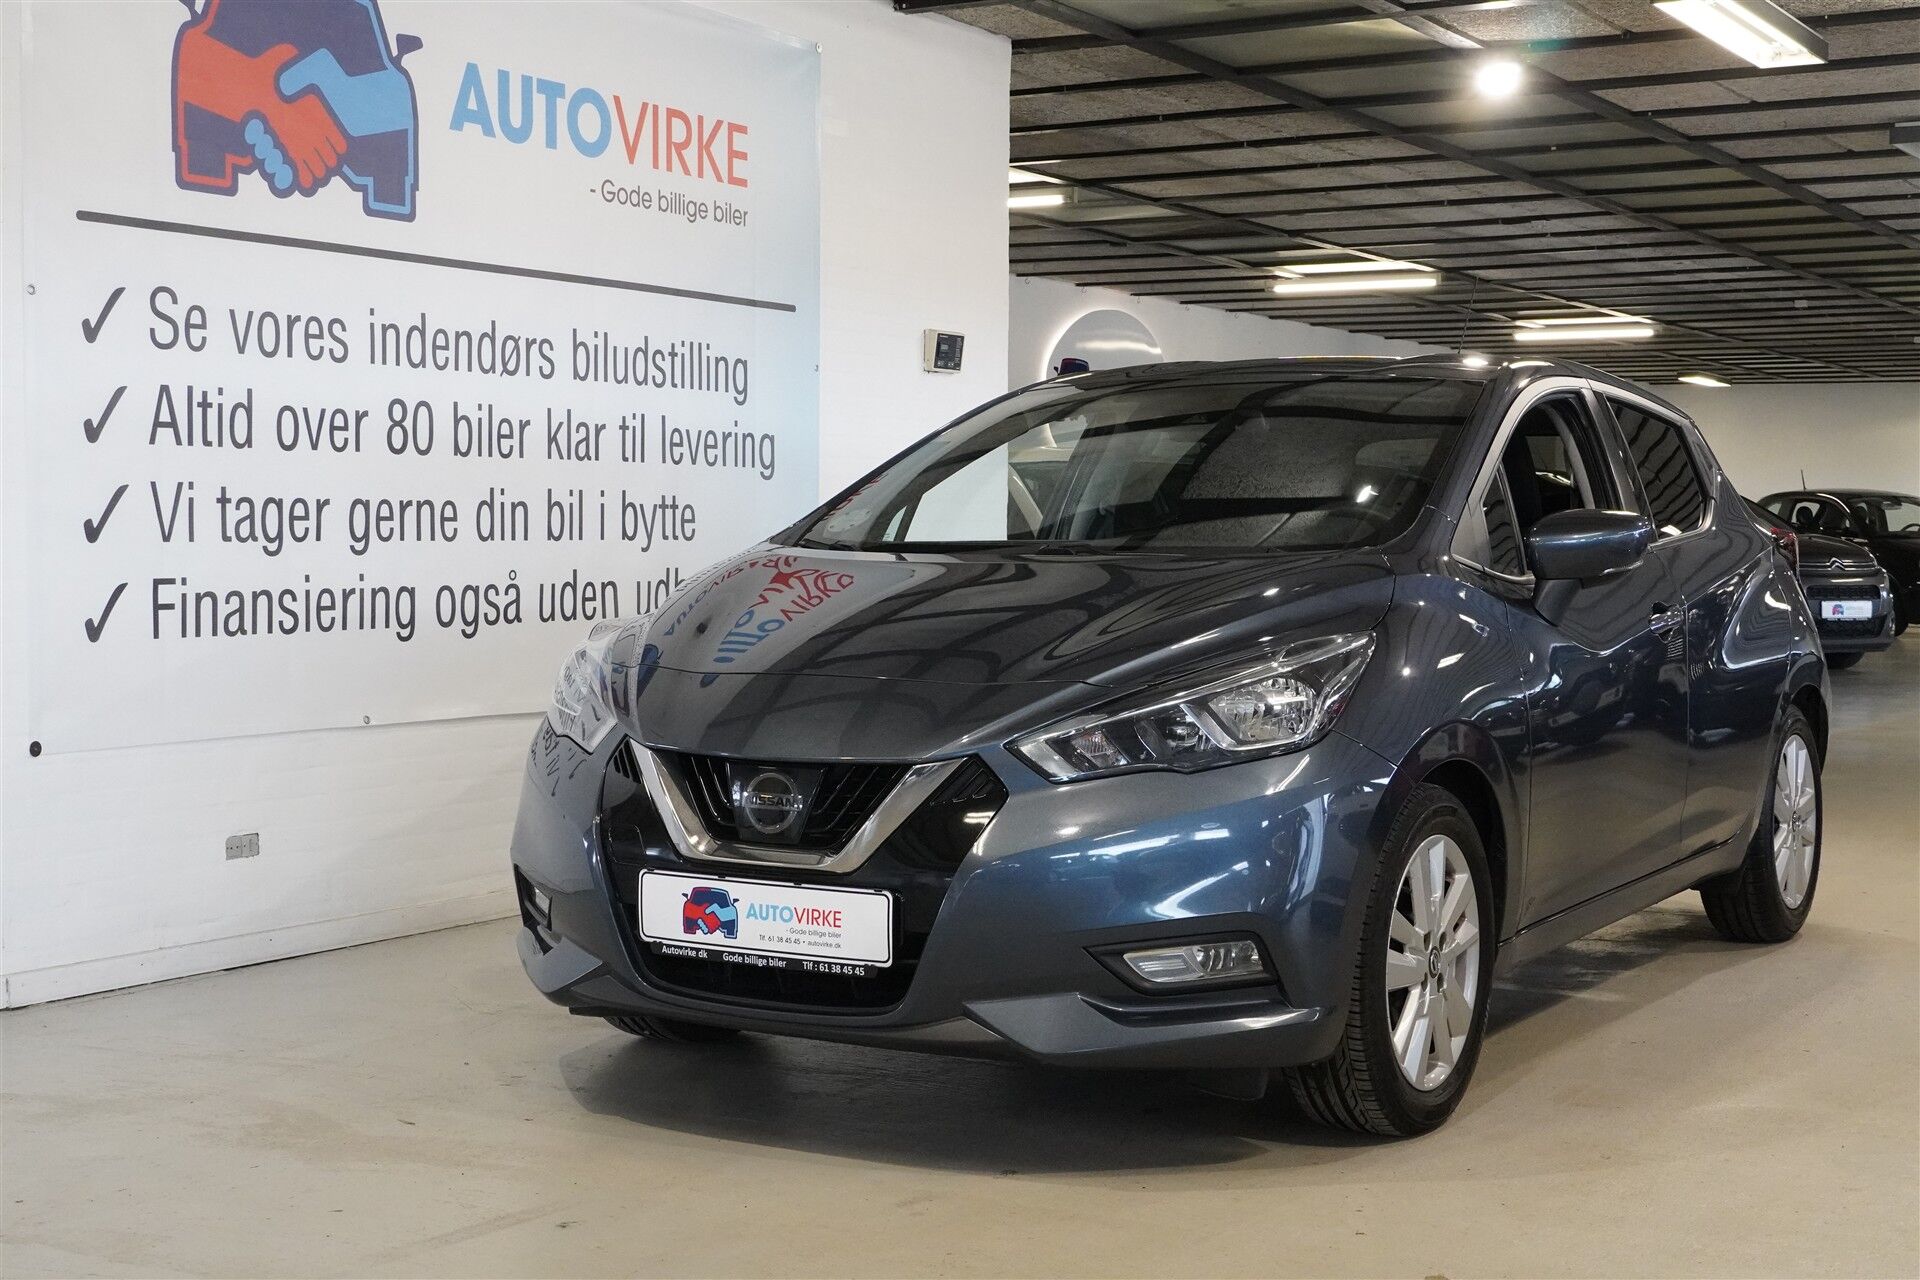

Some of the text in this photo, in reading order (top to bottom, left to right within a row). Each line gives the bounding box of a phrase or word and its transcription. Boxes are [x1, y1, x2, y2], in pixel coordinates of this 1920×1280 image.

[450, 62, 748, 188] AUTOVIRKE
[601, 179, 653, 210] Gode
[658, 189, 709, 223] billige
[713, 200, 749, 227] biler
[149, 285, 748, 406] Se vores indendørs biludstilling
[149, 384, 775, 481] Altid over 80 biler klar til levering
[150, 481, 696, 557] Vi tager gerne din bil i bytte
[152, 573, 416, 643] Finansiering
[435, 569, 523, 640] også
[538, 568, 620, 624] uden
[746, 902, 842, 928] AUTOVIRKE
[789, 927, 807, 936] Gode
[808, 929, 827, 939] billige
[828, 931, 842, 939] biler
[661, 945, 697, 958] Autovirke
[698, 949, 709, 959] dk
[722, 952, 743, 963] Gode
[744, 955, 768, 967] billige
[768, 958, 787, 968] biler
[819, 963, 830, 972] 61
[830, 964, 841, 974] 38
[842, 965, 853, 975] 45
[854, 967, 865, 976] 45
